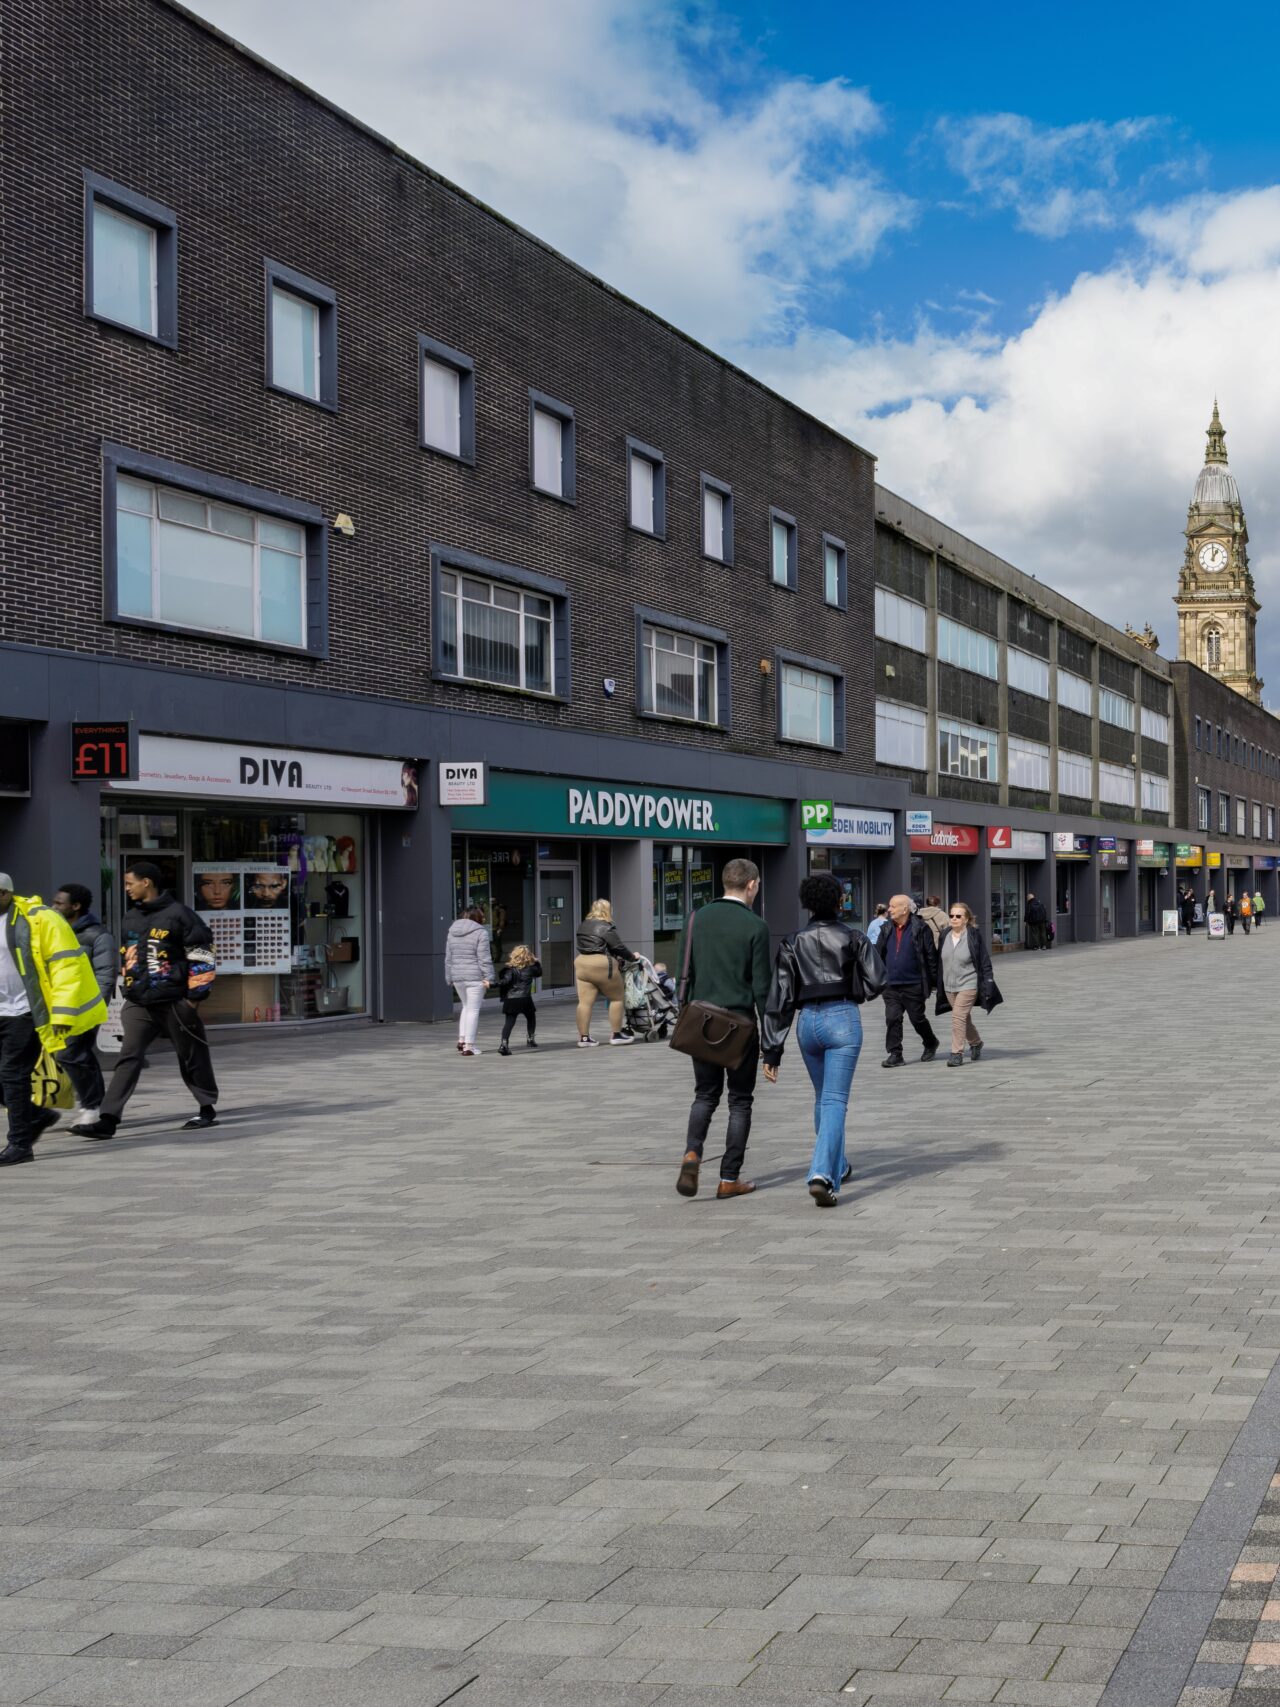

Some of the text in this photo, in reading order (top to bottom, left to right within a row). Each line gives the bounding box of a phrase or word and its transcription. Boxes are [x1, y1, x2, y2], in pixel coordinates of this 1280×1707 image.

[75, 726, 126, 734] EVERYTHING'S
[75, 742, 127, 774] £11
[239, 756, 303, 789] DIVA
[445, 768, 478, 780] DIVA
[832, 818, 893, 836] EDEN MOBILITY
